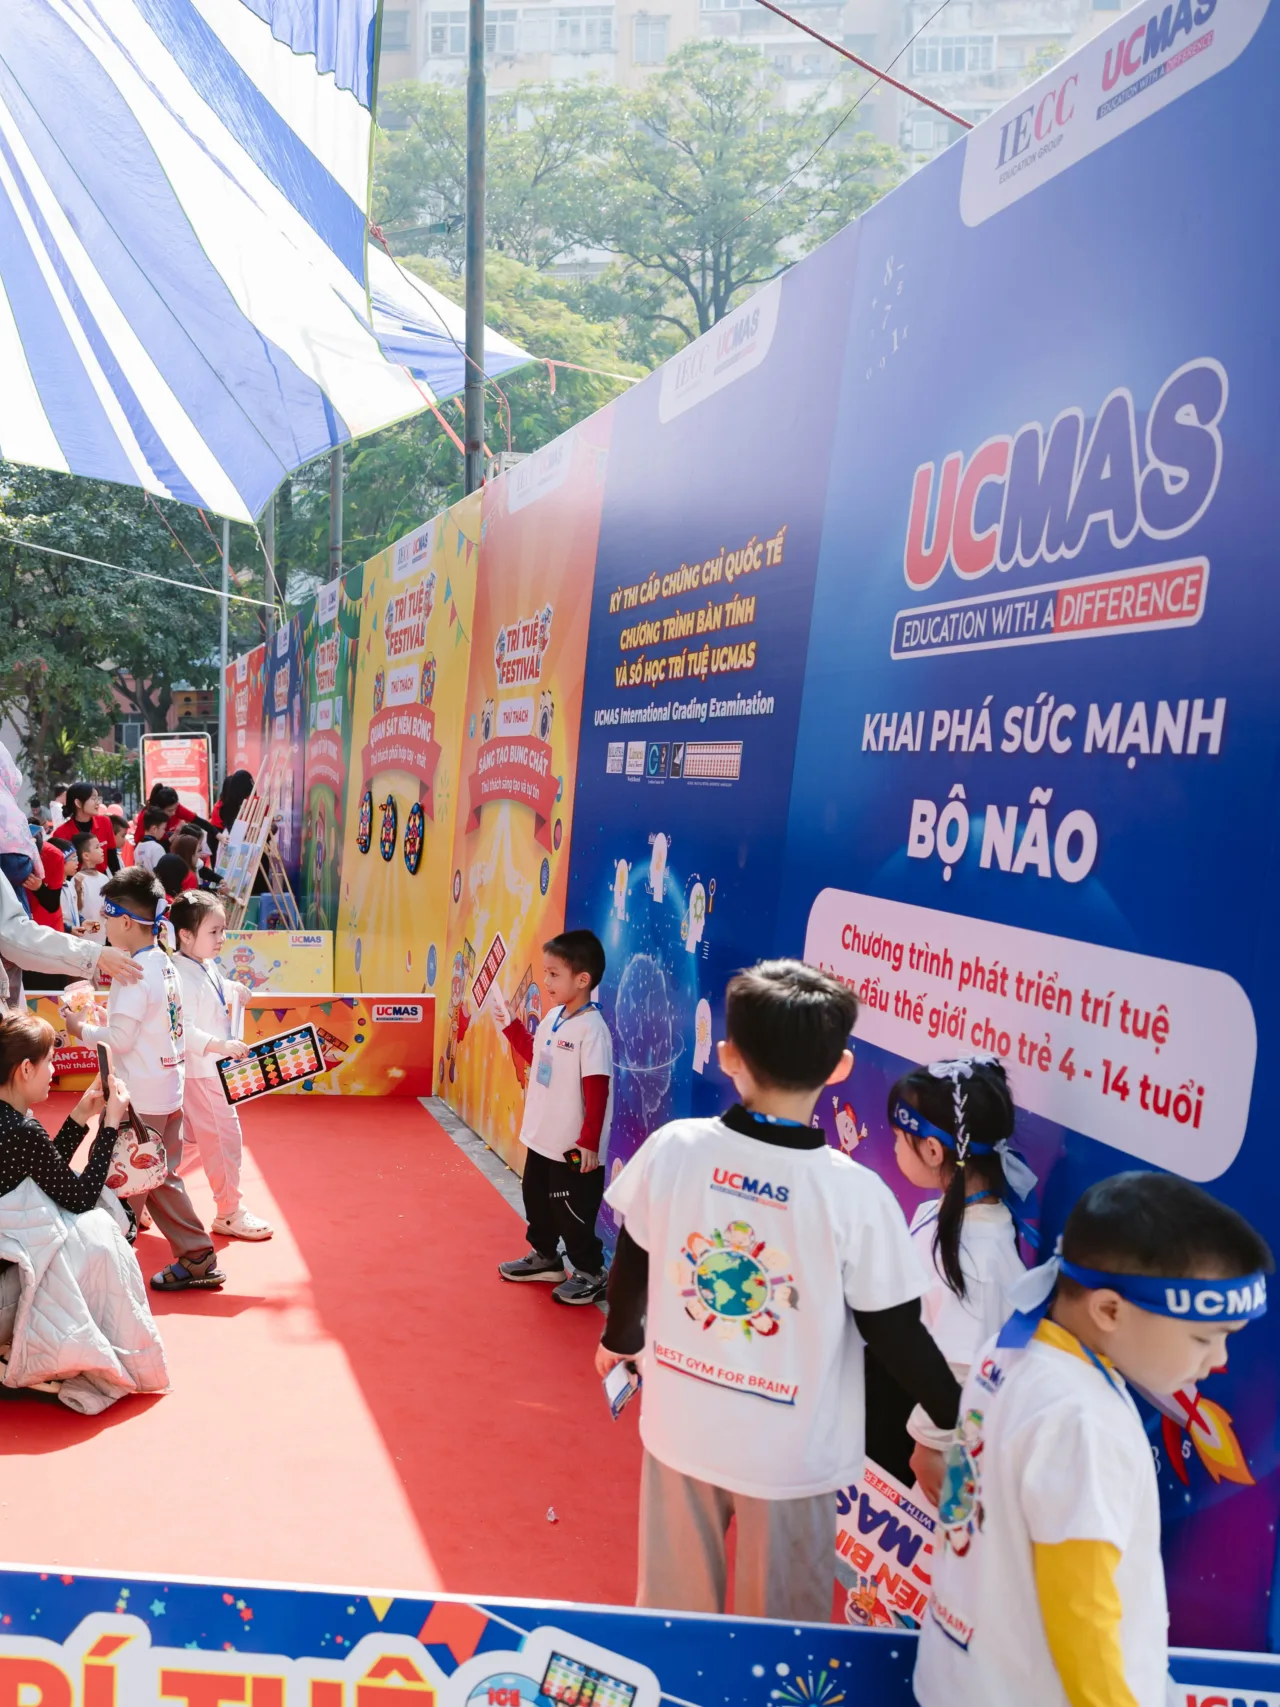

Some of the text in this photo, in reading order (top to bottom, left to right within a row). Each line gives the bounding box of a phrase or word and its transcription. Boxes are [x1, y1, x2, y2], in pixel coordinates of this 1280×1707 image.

[995, 73, 1078, 170] IECC
[716, 308, 760, 361] UCMAS
[904, 356, 1229, 591] UCMAS
[623, 588, 639, 609] THI
[639, 572, 661, 605] CẤP
[661, 563, 700, 598] CHỨNG
[701, 547, 724, 584] CHỈ
[724, 535, 763, 584] QUỐC
[766, 525, 788, 566] TẾ
[394, 588, 409, 624] TRÍ
[620, 594, 756, 650] CHƯƠNG TRÌNH BÀN TÍNH
[901, 574, 1201, 649] EDUCATION WITH A DIFFERENCE
[388, 621, 426, 657] FESTIVAL
[506, 614, 539, 653] TRÍ TUỆ
[501, 653, 540, 685] FESTIVAL
[615, 641, 757, 688] VÀ SỐ HỌC TRÍ TUỆ UCMAS
[594, 690, 775, 726] UCMAS International Grading Examination
[861, 691, 1227, 769] KHAI PHÁ SỨC MẠNH
[478, 745, 549, 777] SÁNG TẠO BUNG CHẤT
[907, 783, 1099, 884] BỘ NÃO
[291, 935, 322, 944] UCMAS
[841, 923, 1170, 1055] Chương trình phát triển trí tuệ
[376, 1006, 418, 1016] UCMAS
[81, 1050, 97, 1060] TẠ
[557, 1040, 574, 1050] UCMA
[859, 977, 890, 1012] đầu
[894, 990, 924, 1026] thế
[928, 1005, 967, 1041] giới
[971, 1017, 1011, 1057] cho
[1018, 1031, 1052, 1072] trẻ
[1058, 1047, 1076, 1082] 4
[1102, 1059, 1131, 1102] 14
[1139, 1075, 1206, 1129] tuổi
[56, 1061, 96, 1070] Thử thách
[713, 1167, 789, 1202] UCMAS
[1165, 1274, 1267, 1315] UCMA
[656, 1343, 684, 1365] BEST
[686, 1356, 715, 1375] GYM
[717, 1366, 745, 1384] FOR
[864, 1468, 899, 1502] DIFFER
[905, 1502, 934, 1531] WITH
